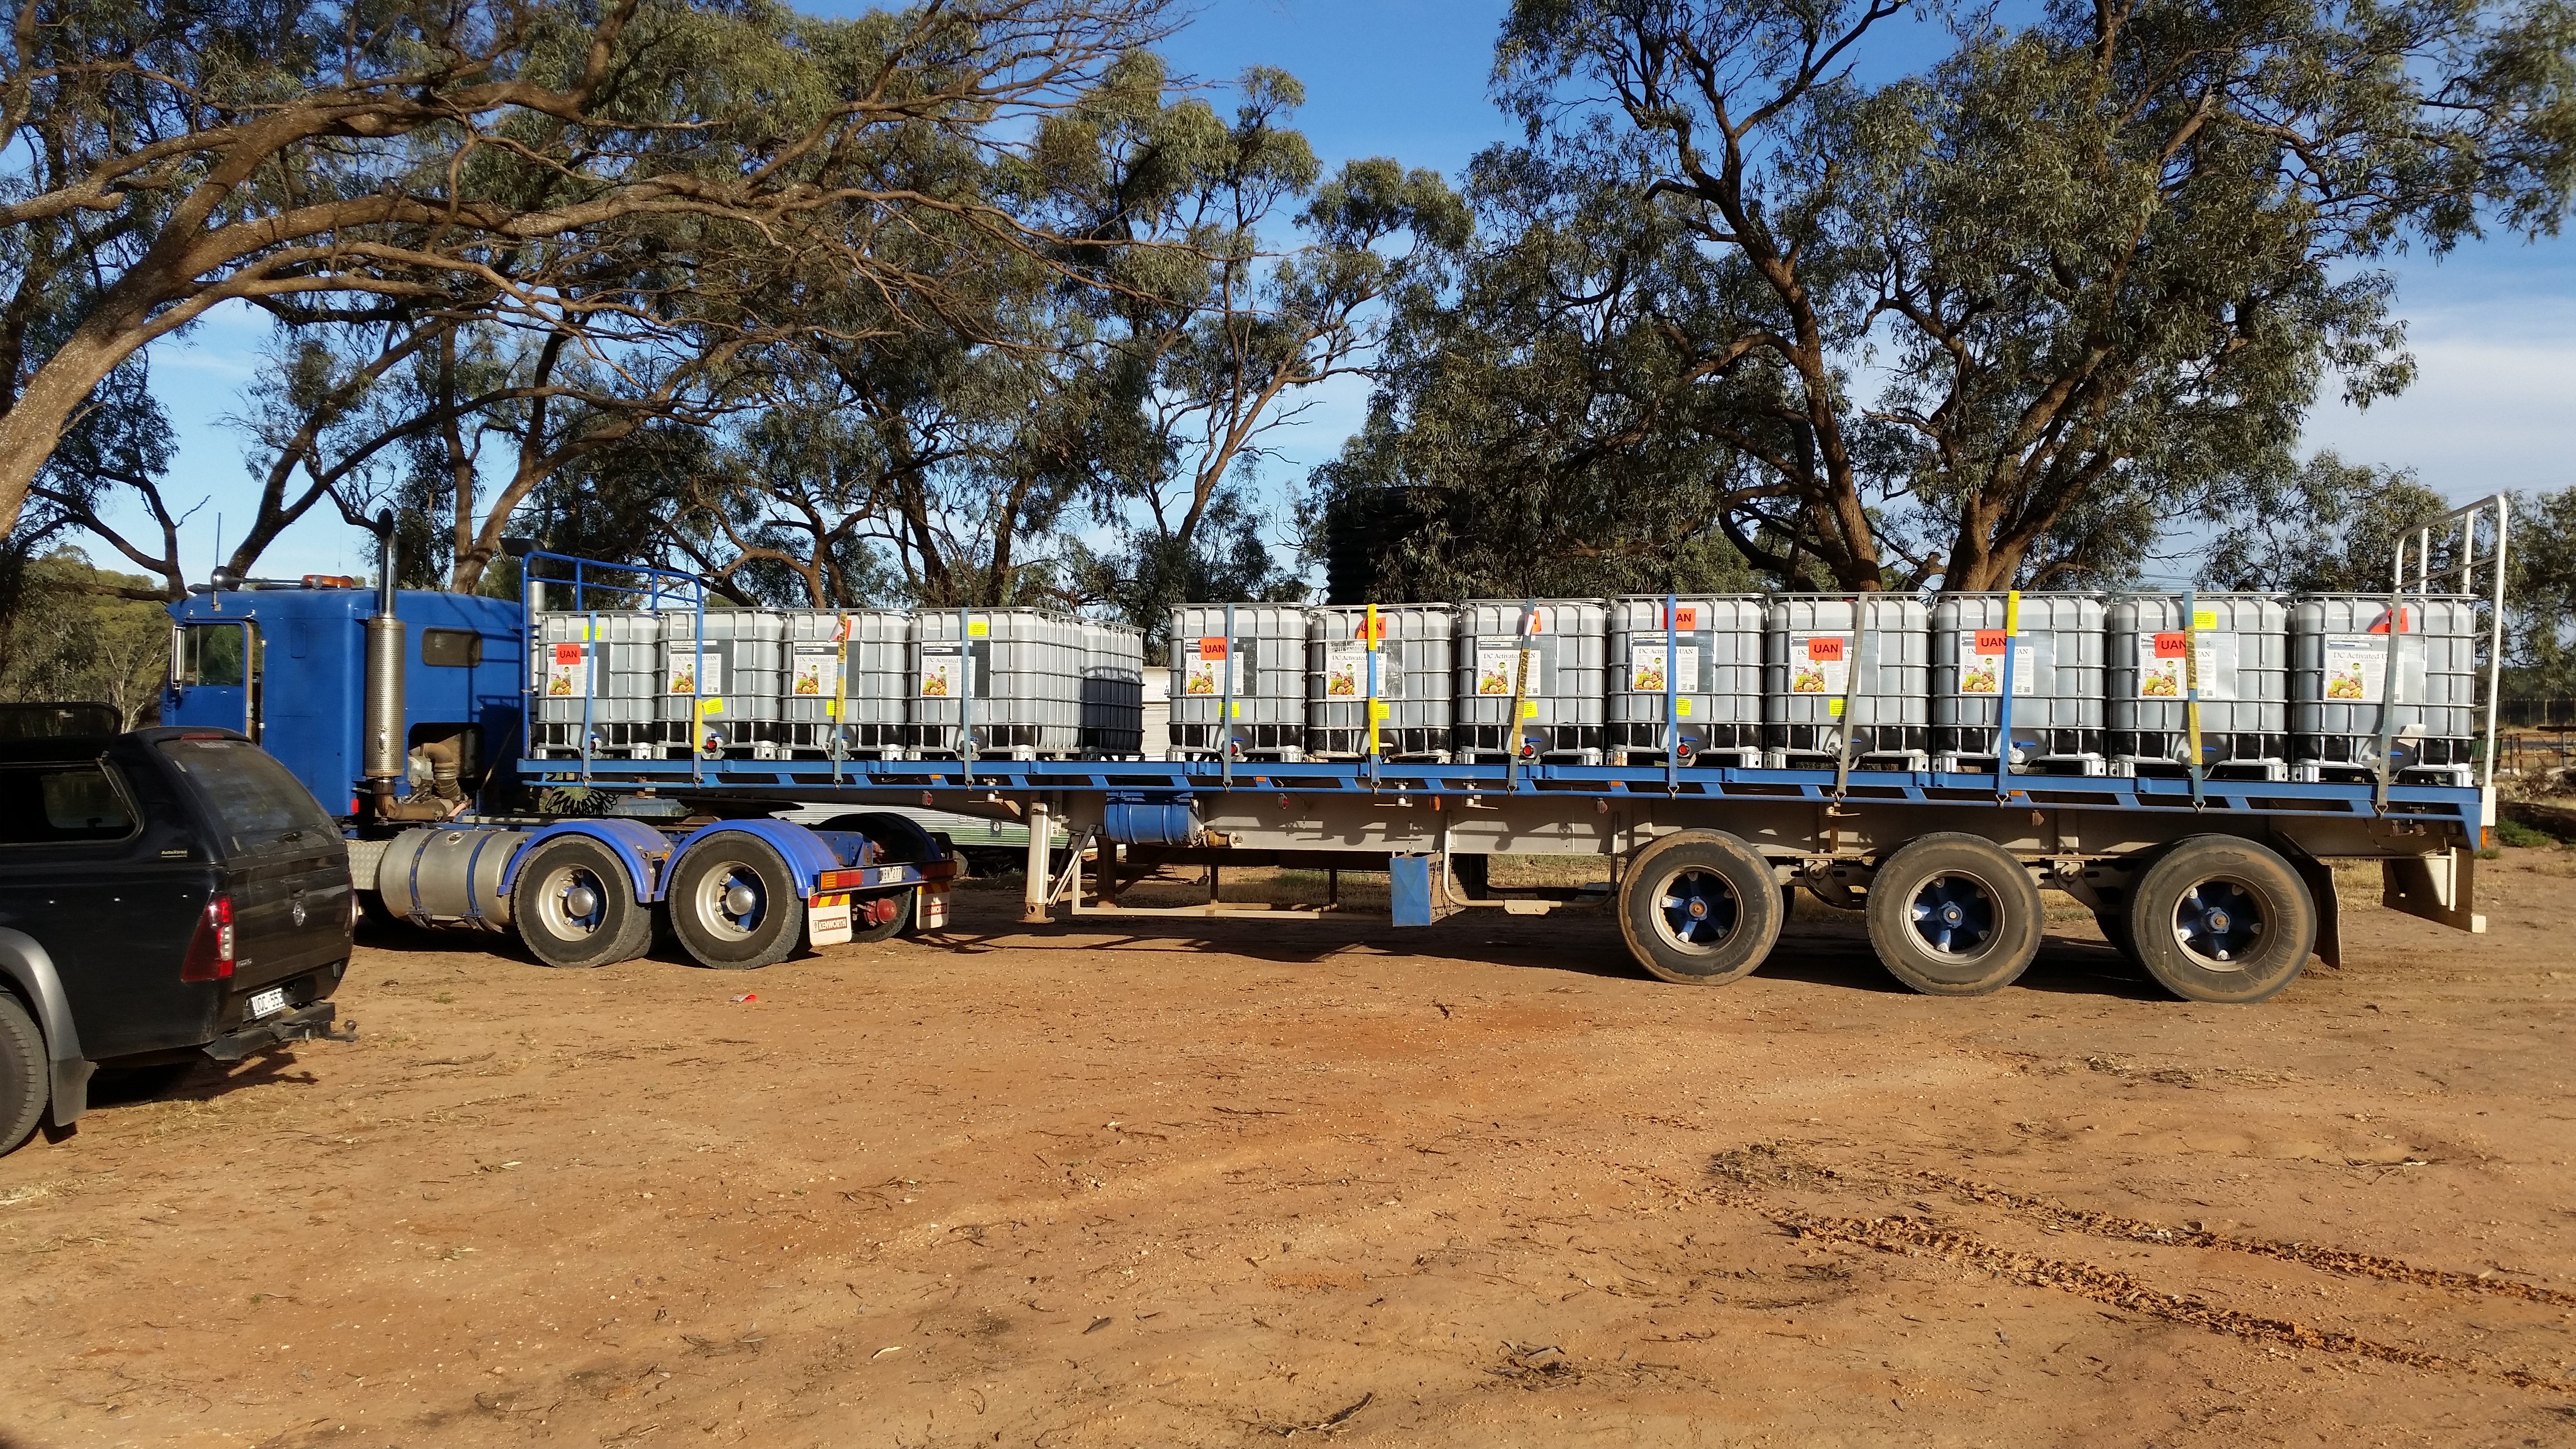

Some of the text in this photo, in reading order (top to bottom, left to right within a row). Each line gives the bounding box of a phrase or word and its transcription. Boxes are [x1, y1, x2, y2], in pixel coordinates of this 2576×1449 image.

[1676, 613, 1691, 622] AN
[1361, 622, 1382, 632] UN
[1981, 638, 2007, 647] UAN
[1205, 644, 1225, 653] UAN
[1814, 644, 1838, 653] UAN
[819, 918, 847, 930] KENWORTH
